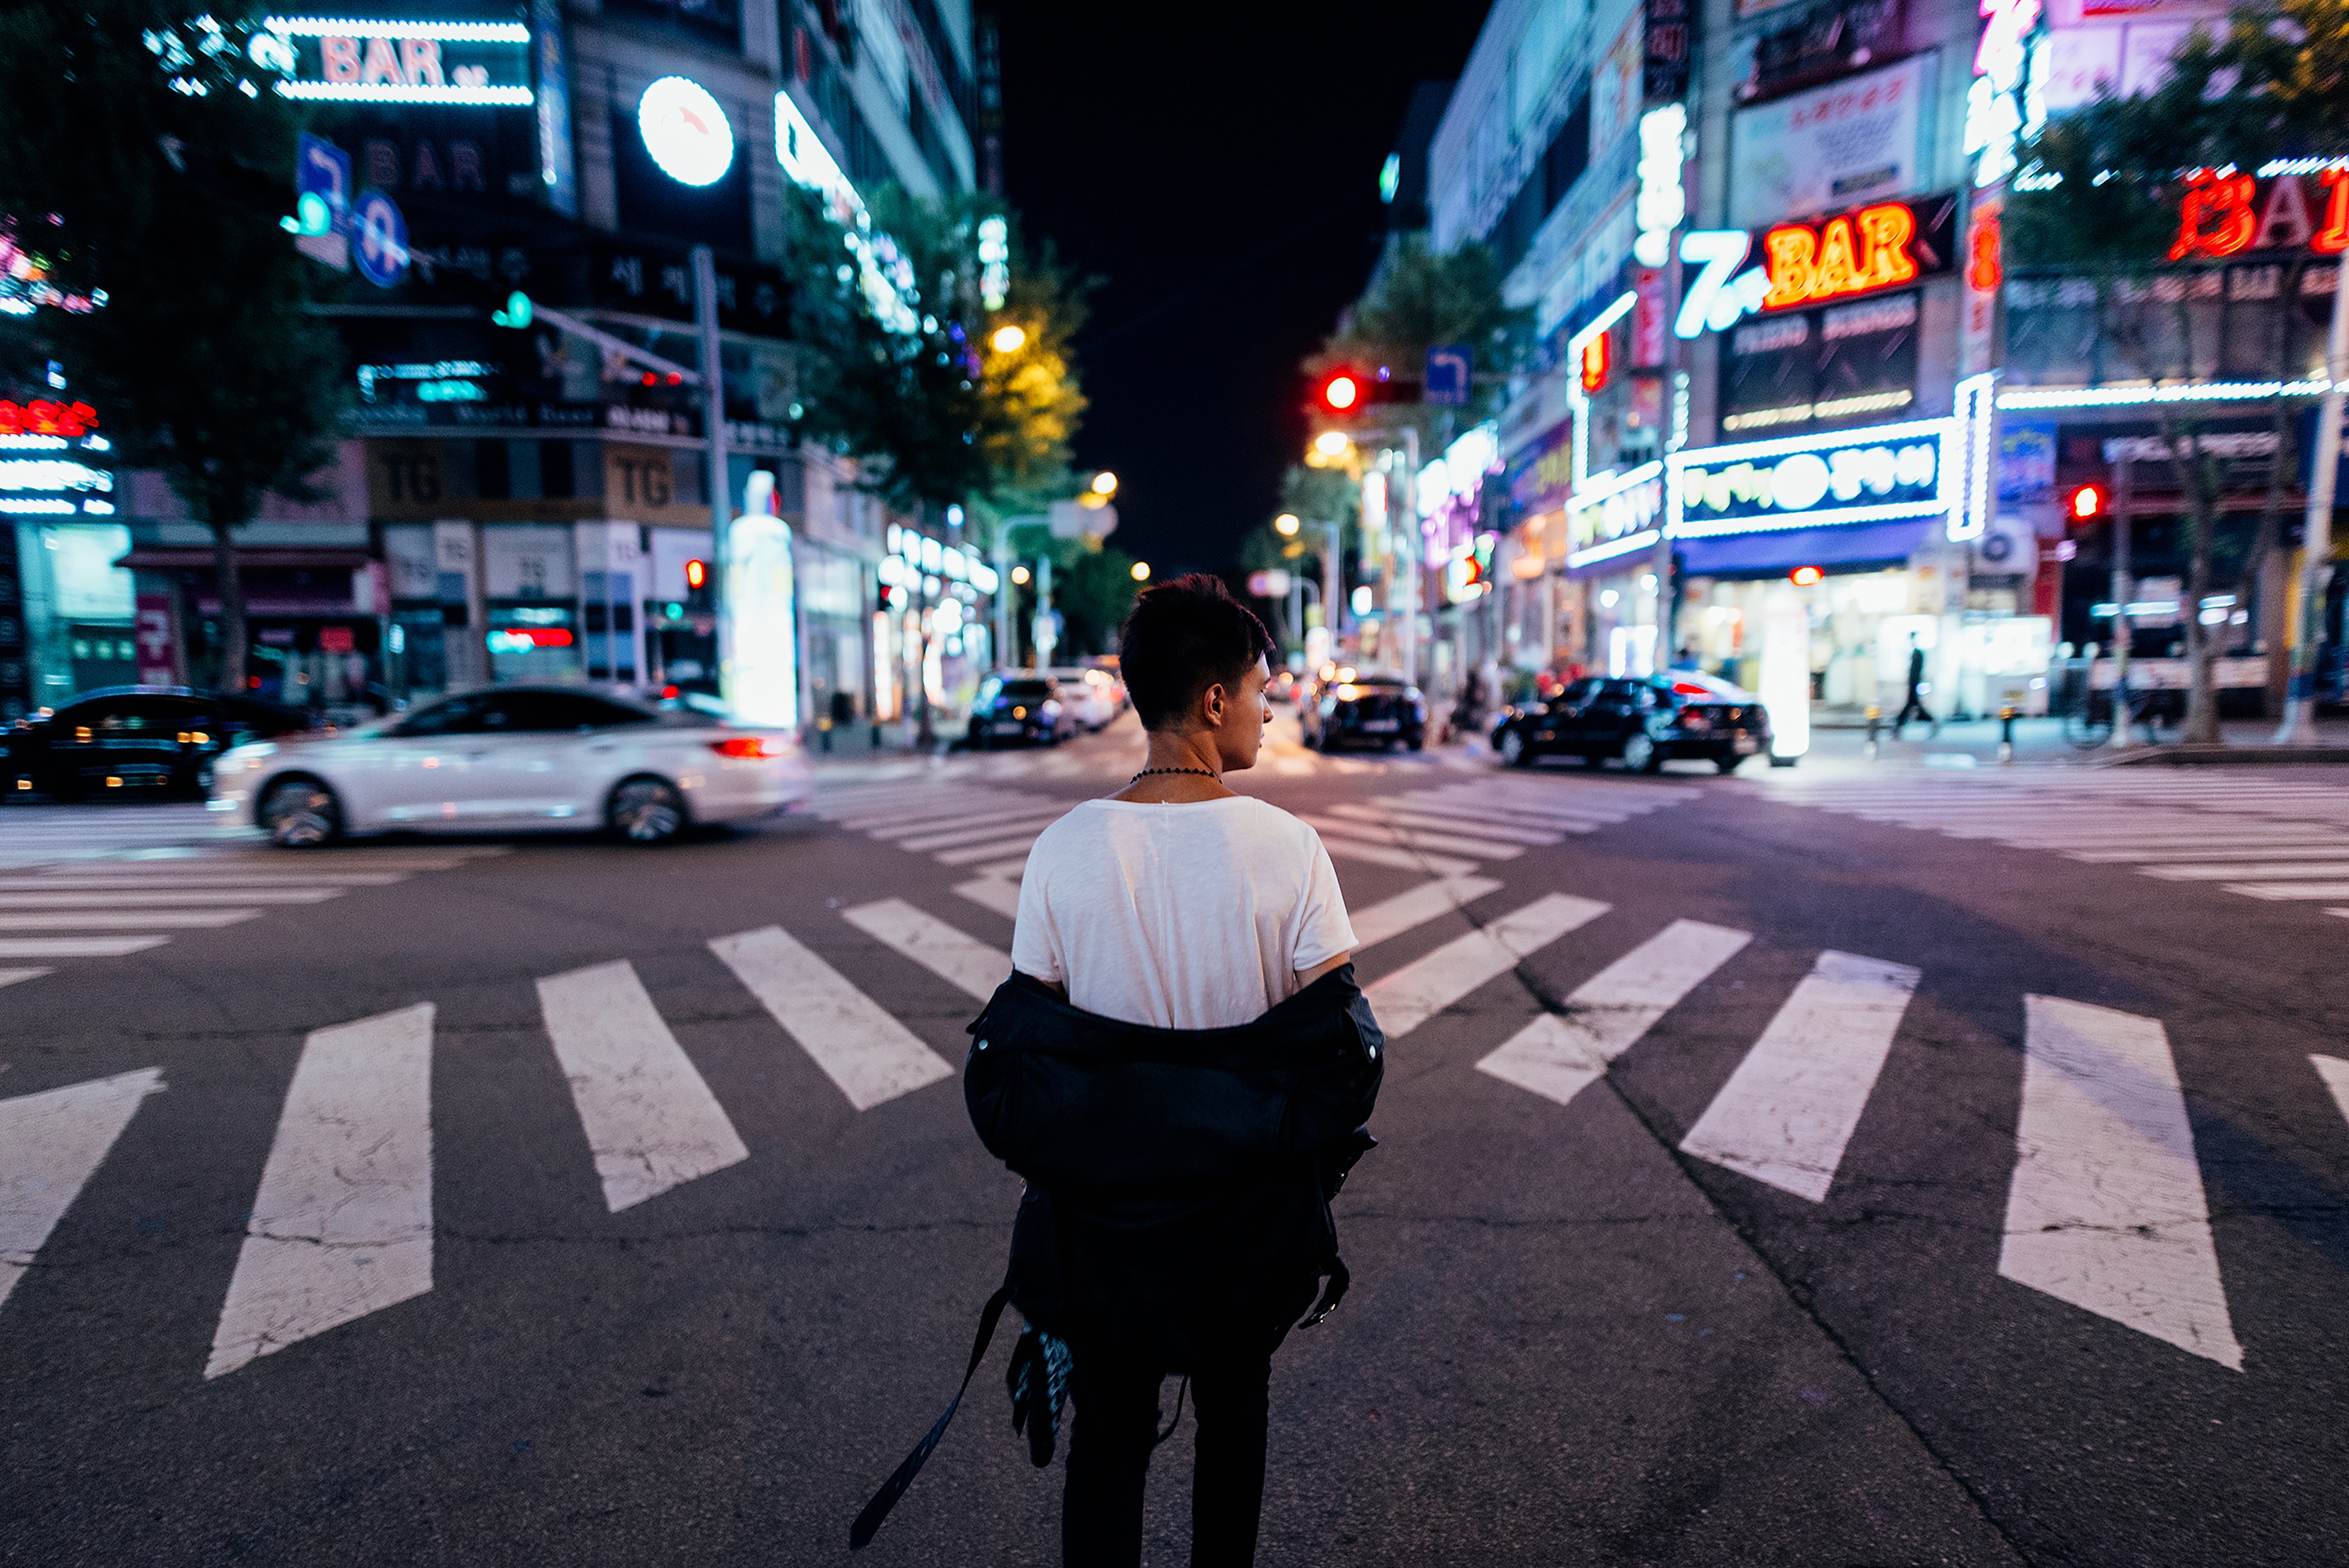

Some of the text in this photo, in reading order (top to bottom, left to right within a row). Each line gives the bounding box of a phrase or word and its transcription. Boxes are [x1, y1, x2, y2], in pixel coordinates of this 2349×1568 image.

[320, 36, 445, 86] BAR
[365, 139, 486, 191] BAR
[1763, 203, 1918, 310] BAR
[382, 453, 440, 503] TG
[616, 456, 672, 507] TG
